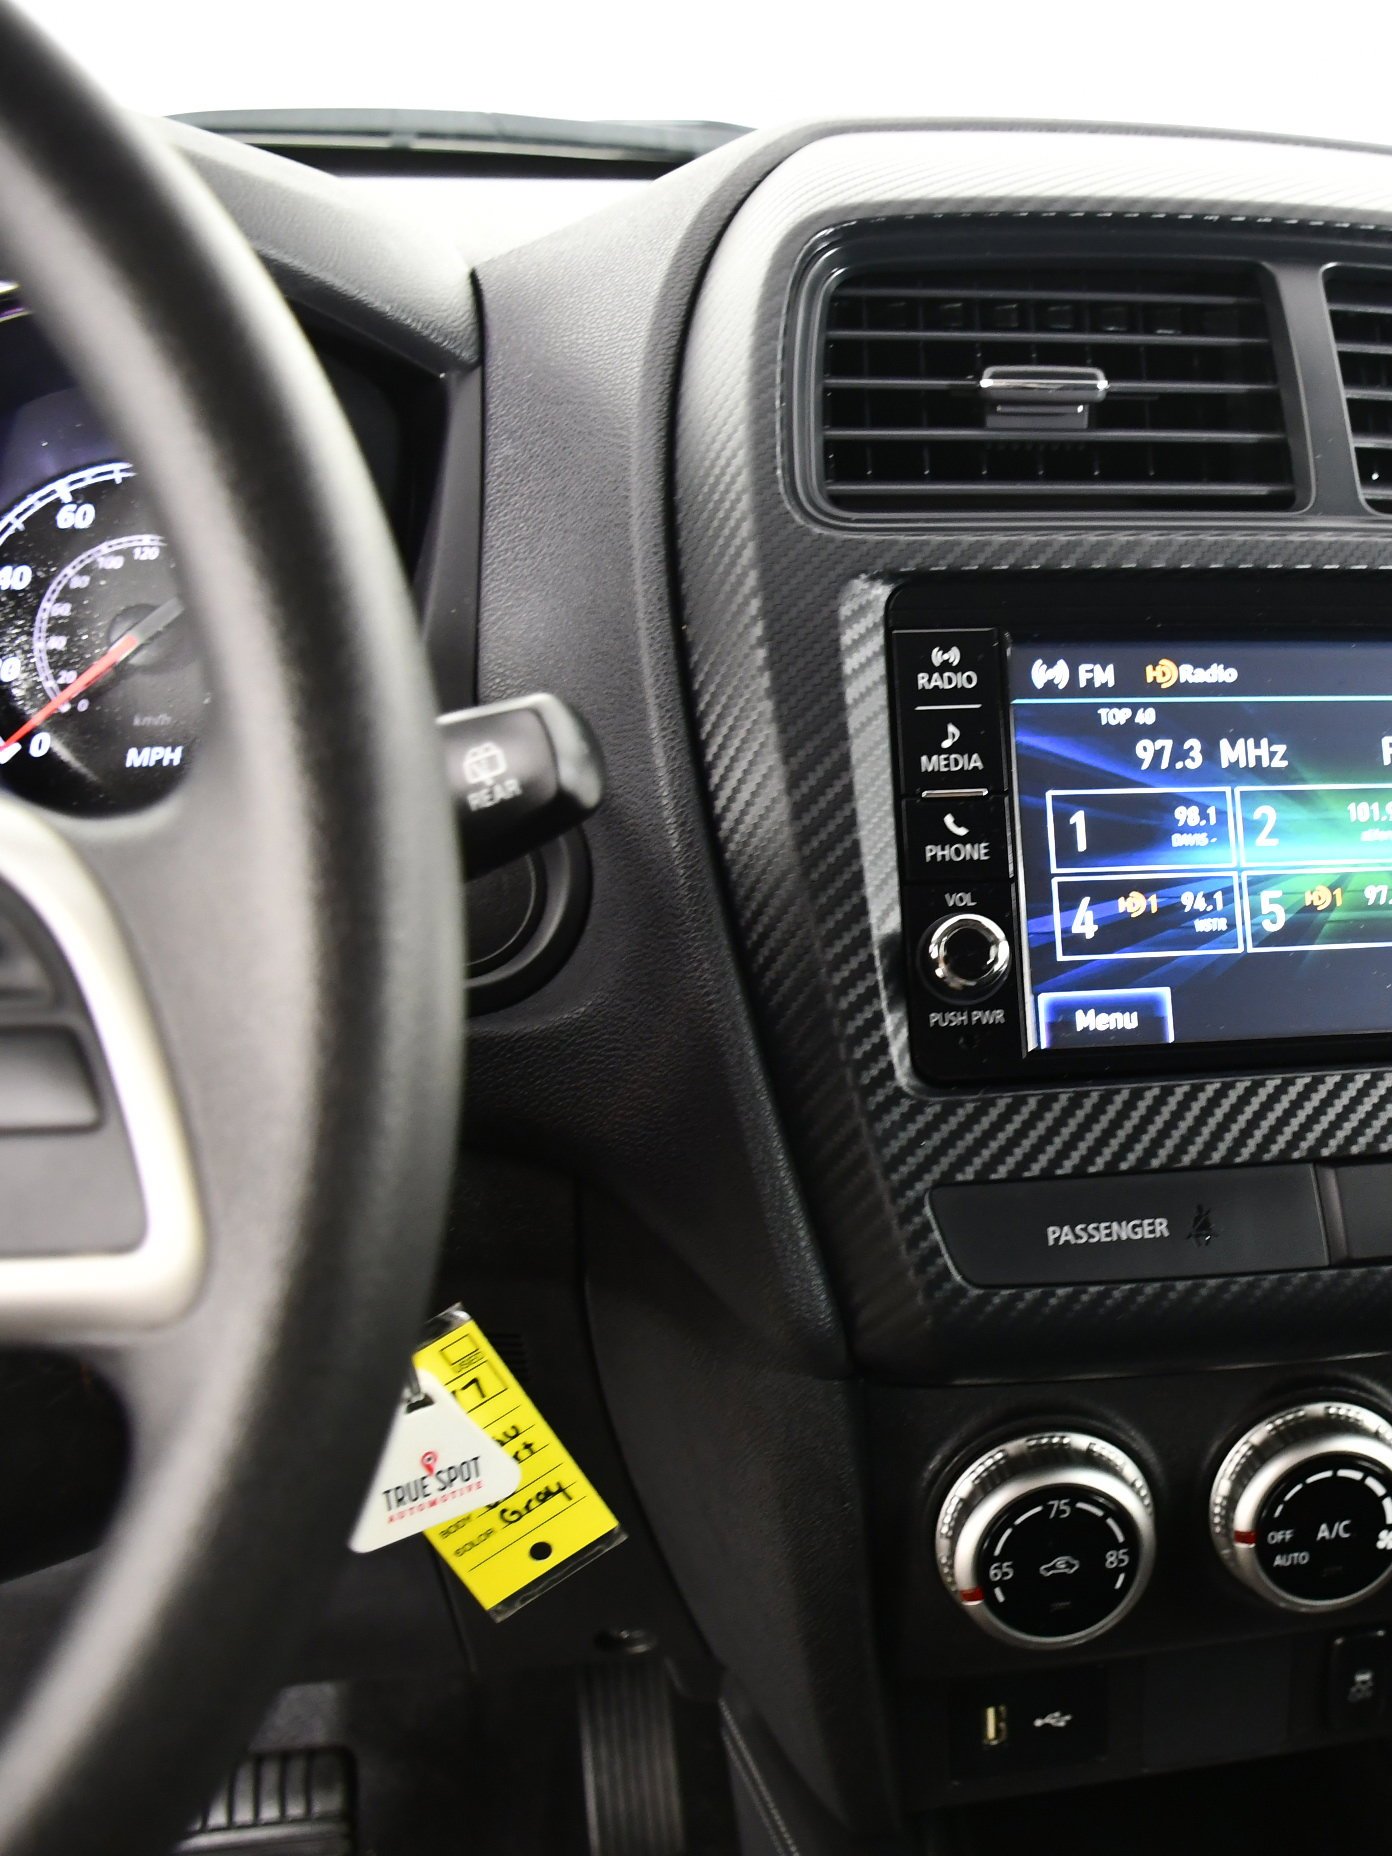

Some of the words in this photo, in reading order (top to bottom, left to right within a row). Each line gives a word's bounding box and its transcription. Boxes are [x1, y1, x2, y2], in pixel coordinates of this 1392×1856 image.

[56, 503, 95, 529] 60
[0, 656, 21, 682] 0
[918, 670, 977, 690] RADIO
[1079, 664, 1115, 688] FM
[1098, 708, 1131, 726] TOP
[29, 732, 50, 757] 0
[1135, 739, 1203, 770] 97.3
[1220, 738, 1288, 768] MHz
[126, 746, 183, 768] MPH
[921, 753, 983, 772] MEDIA
[1174, 805, 1217, 827] 98.1
[1253, 805, 1279, 847] 2
[1069, 810, 1087, 852] 1
[925, 842, 990, 862] PHONE
[945, 892, 977, 907] VOL
[1180, 890, 1223, 913] 94.1
[1071, 896, 1098, 939] 4
[1260, 890, 1286, 932] 5
[929, 1010, 968, 1027] PUSH
[972, 1009, 1005, 1025] PWR
[1075, 1009, 1138, 1031] Menu
[1047, 1217, 1170, 1246] PASSENGER
[382, 1475, 432, 1512] TRUE
[435, 1456, 481, 1492] SPOT
[1048, 1499, 1071, 1519] 75
[1267, 1529, 1294, 1545] OFF
[1316, 1520, 1351, 1541] A/C
[1105, 1548, 1129, 1569] 85
[1273, 1551, 1309, 1567] AUTO
[989, 1561, 1014, 1581] 65
